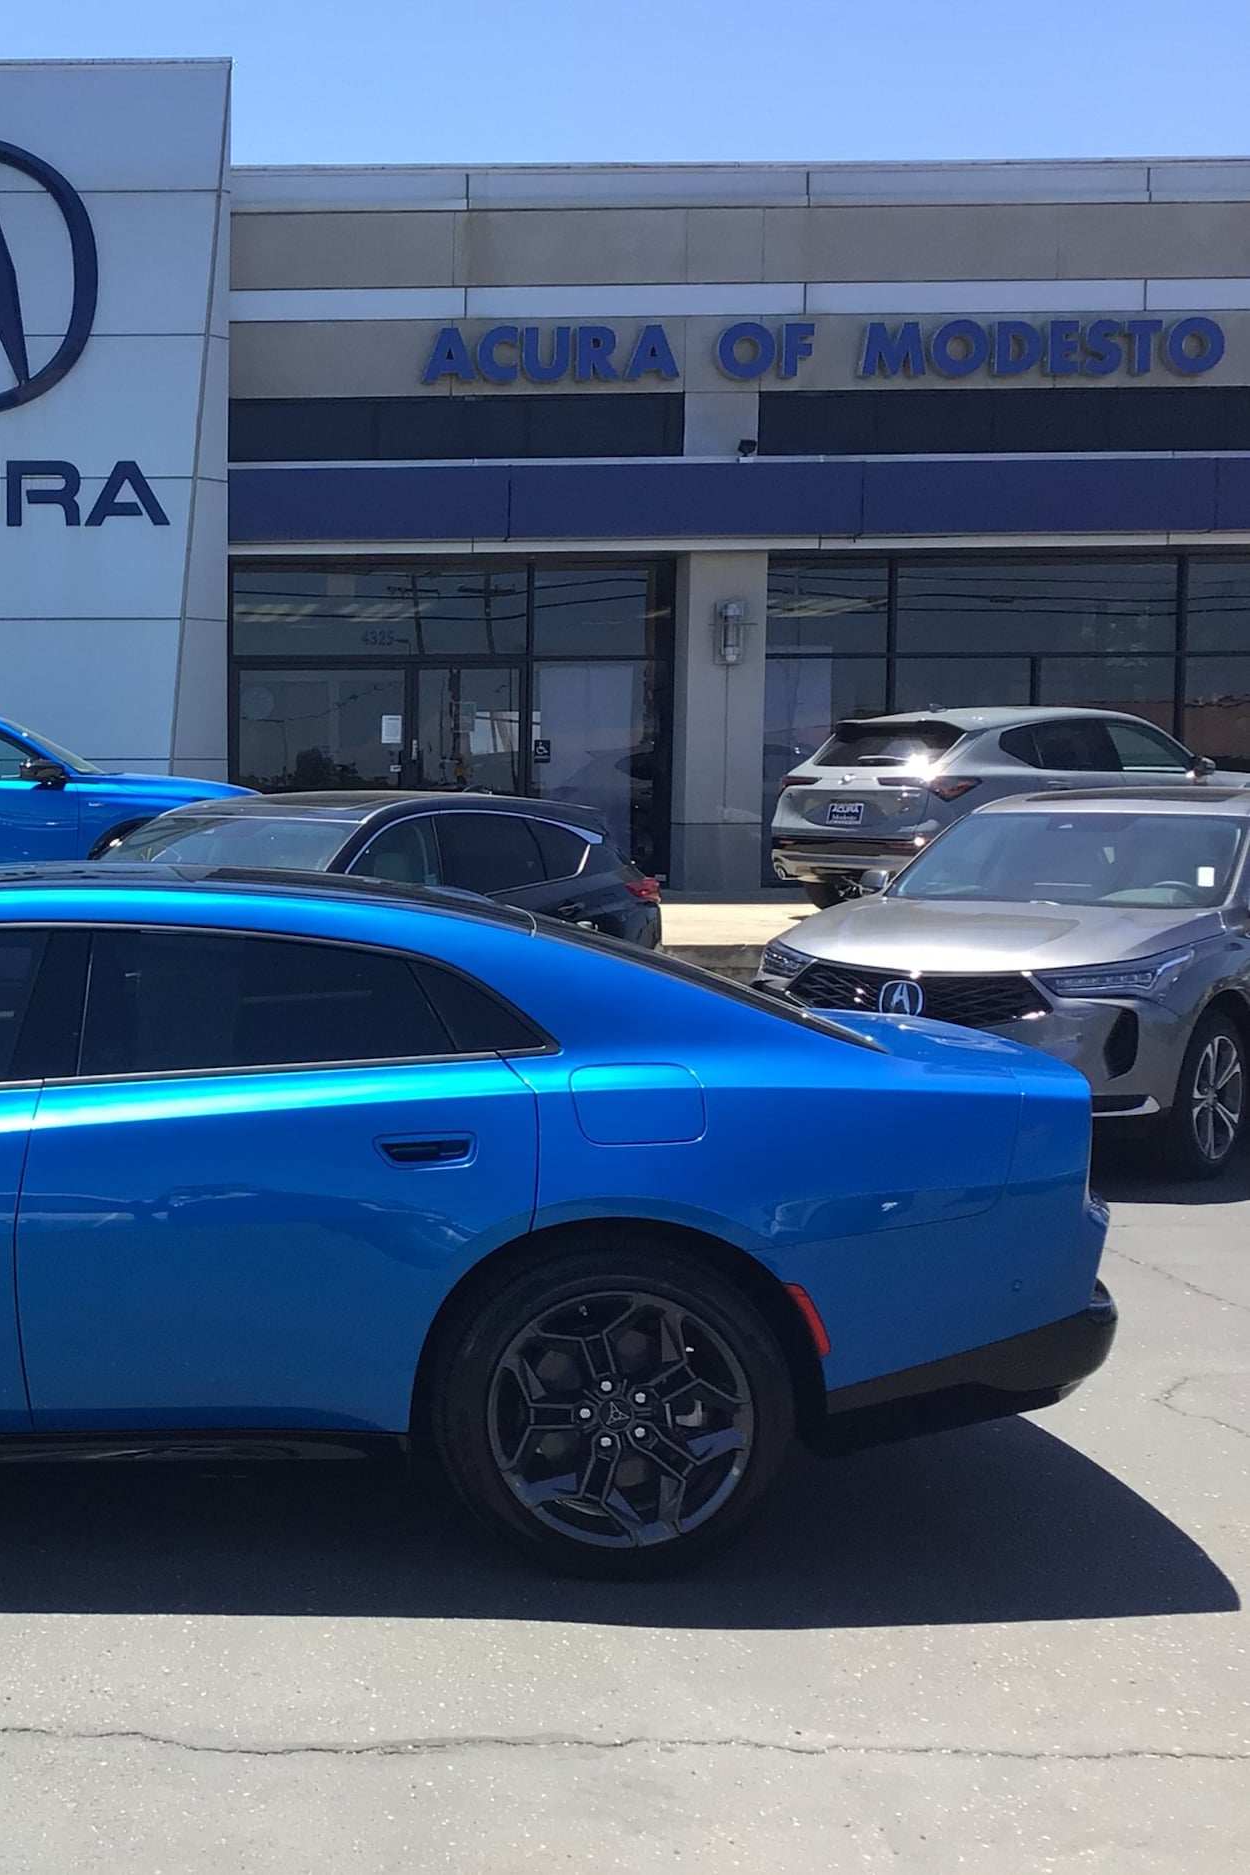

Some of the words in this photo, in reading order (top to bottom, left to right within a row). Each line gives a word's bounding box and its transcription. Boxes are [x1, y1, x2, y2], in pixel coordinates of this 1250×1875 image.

[421, 324, 680, 384] ACURA
[717, 321, 816, 380] OF
[860, 316, 1226, 377] MODESTO
[361, 630, 395, 646] 4325
[831, 804, 860, 813] ACURA
